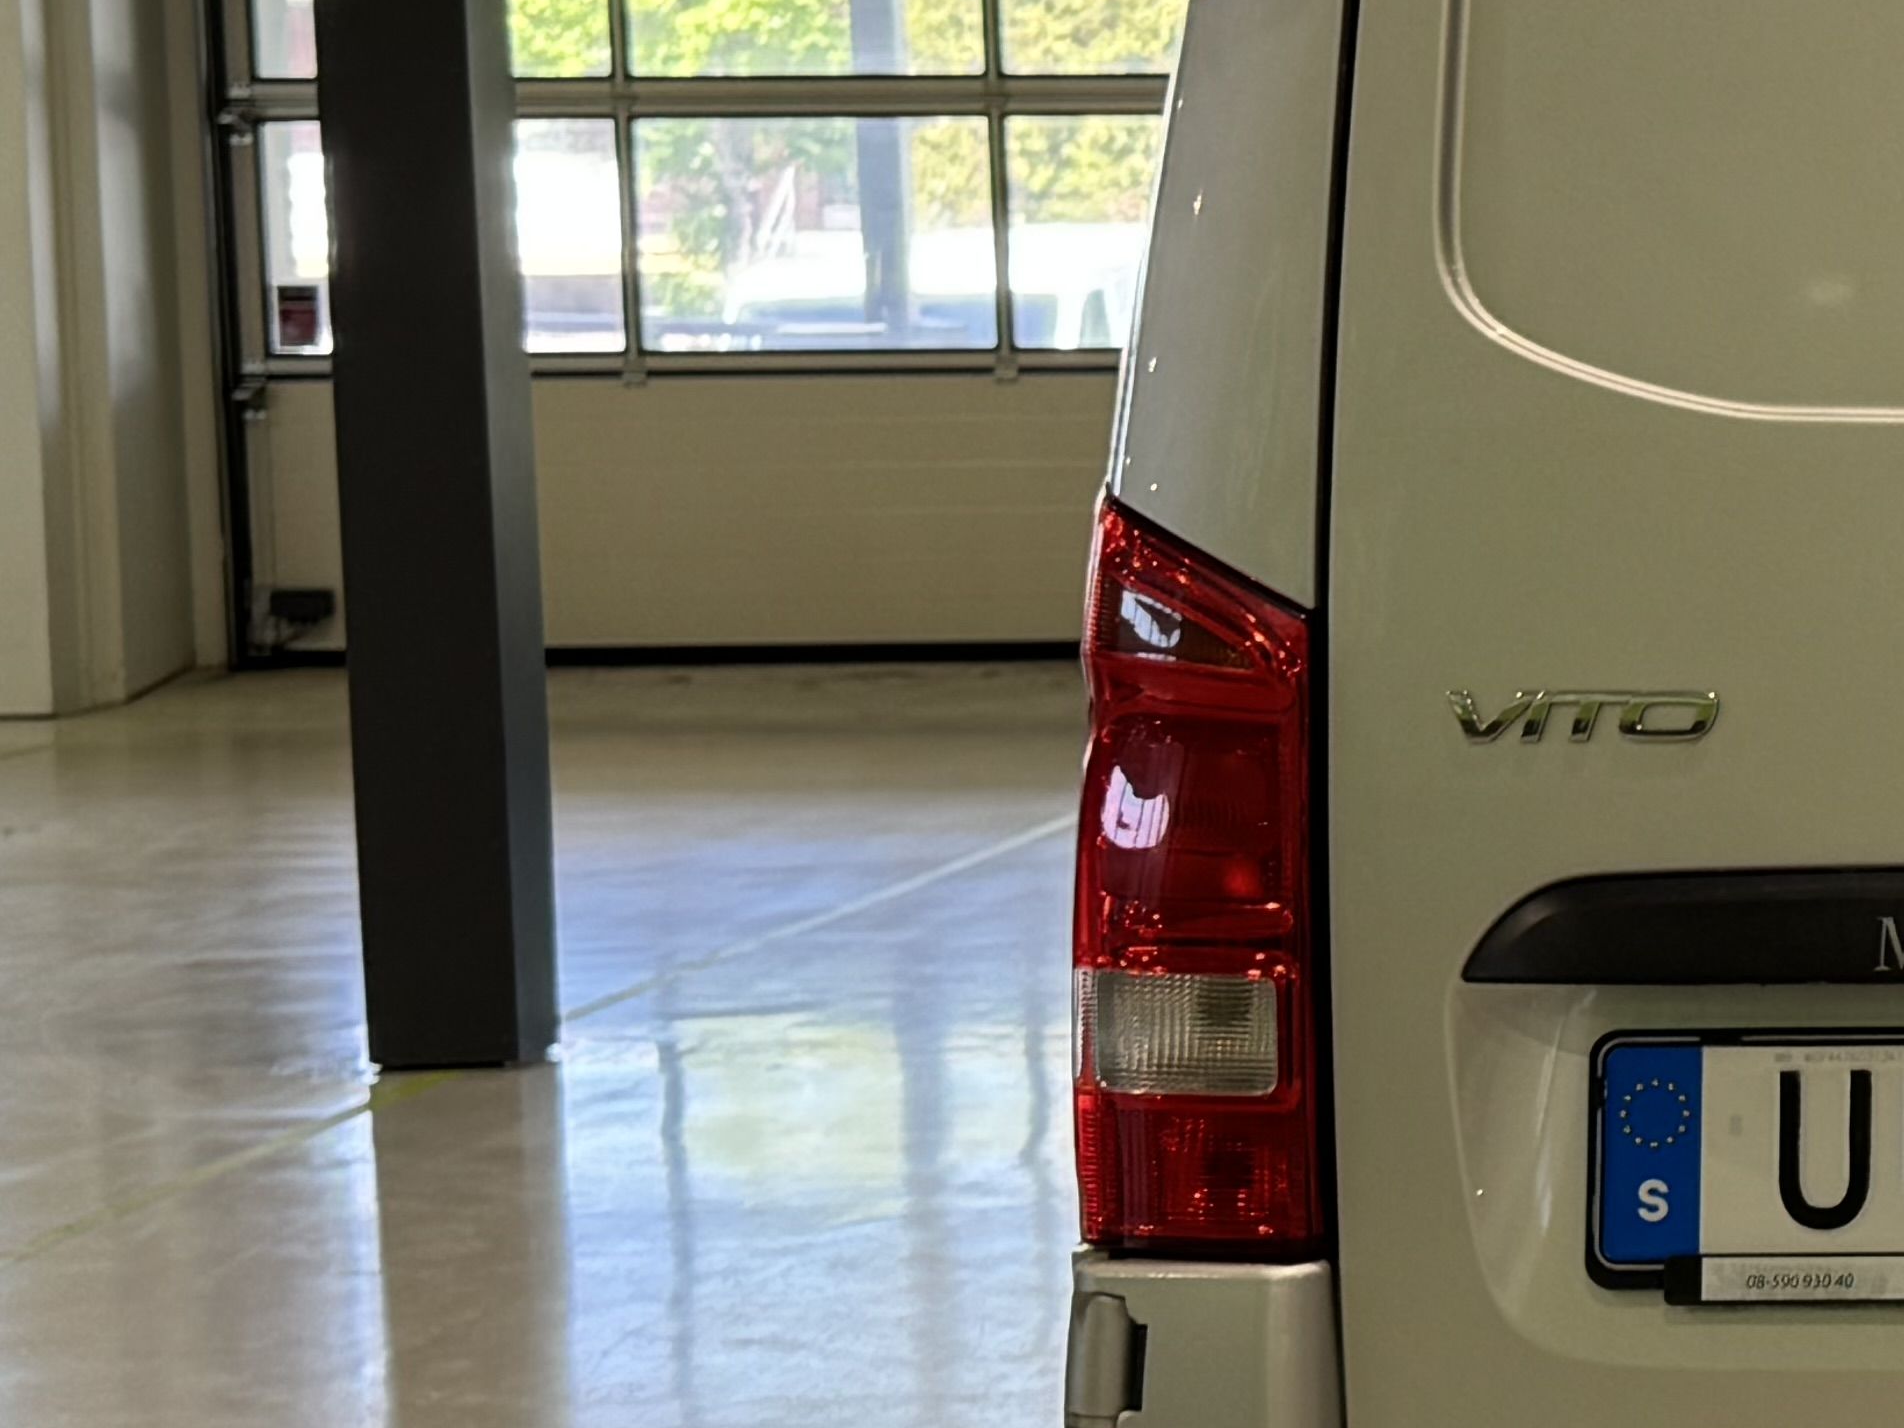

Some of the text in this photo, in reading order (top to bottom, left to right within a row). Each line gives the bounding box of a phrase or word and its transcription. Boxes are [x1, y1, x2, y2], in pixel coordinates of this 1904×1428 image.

[1446, 689, 1720, 743] VITO
[1637, 1178, 1670, 1223] S
[1834, 1273, 1855, 1289] 40
